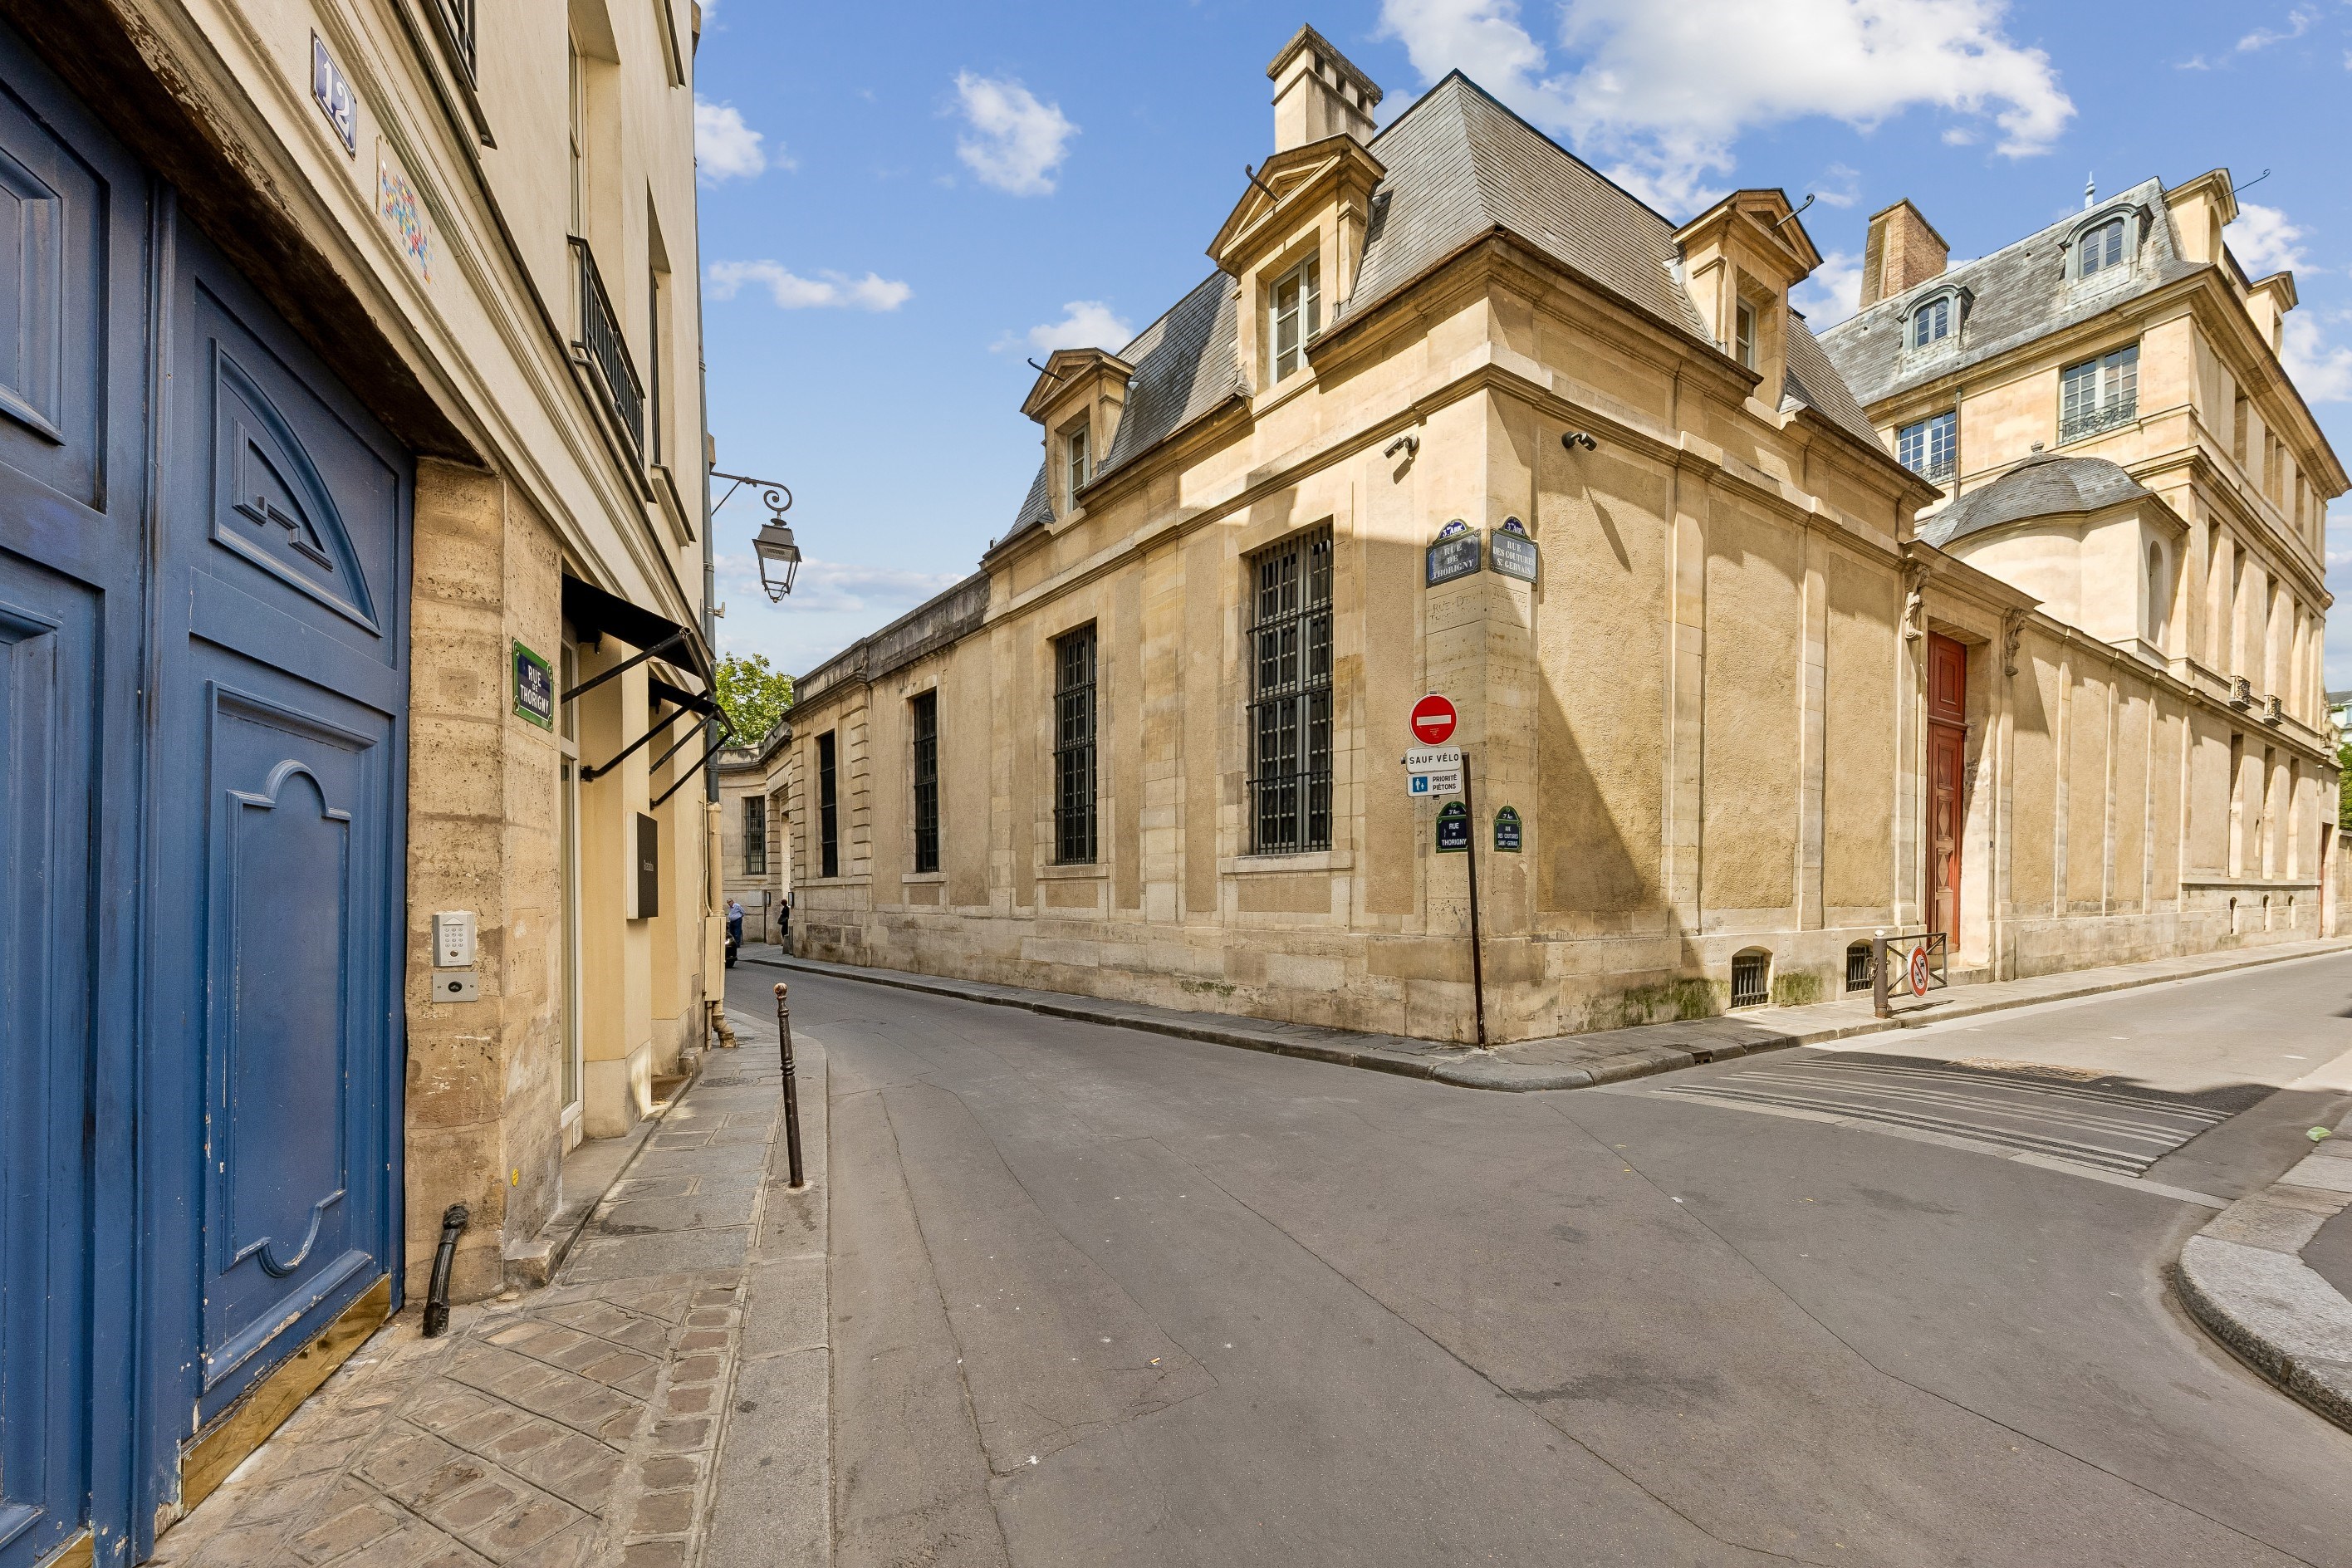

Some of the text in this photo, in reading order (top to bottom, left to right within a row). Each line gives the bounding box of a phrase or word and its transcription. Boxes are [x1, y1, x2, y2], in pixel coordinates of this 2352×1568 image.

[324, 61, 349, 138] 12
[1444, 543, 1462, 556] RUE
[1507, 541, 1521, 552] RUE
[1448, 555, 1458, 564] DE
[1493, 546, 1536, 566] DES COUTURES
[1433, 559, 1473, 578] THORIGNY
[528, 665, 541, 688] RUE
[532, 684, 538, 692] DE
[520, 684, 549, 714] THORIGNY
[1409, 753, 1459, 764] SAUF VÉLO
[1433, 774, 1457, 782] PRIORITÉ
